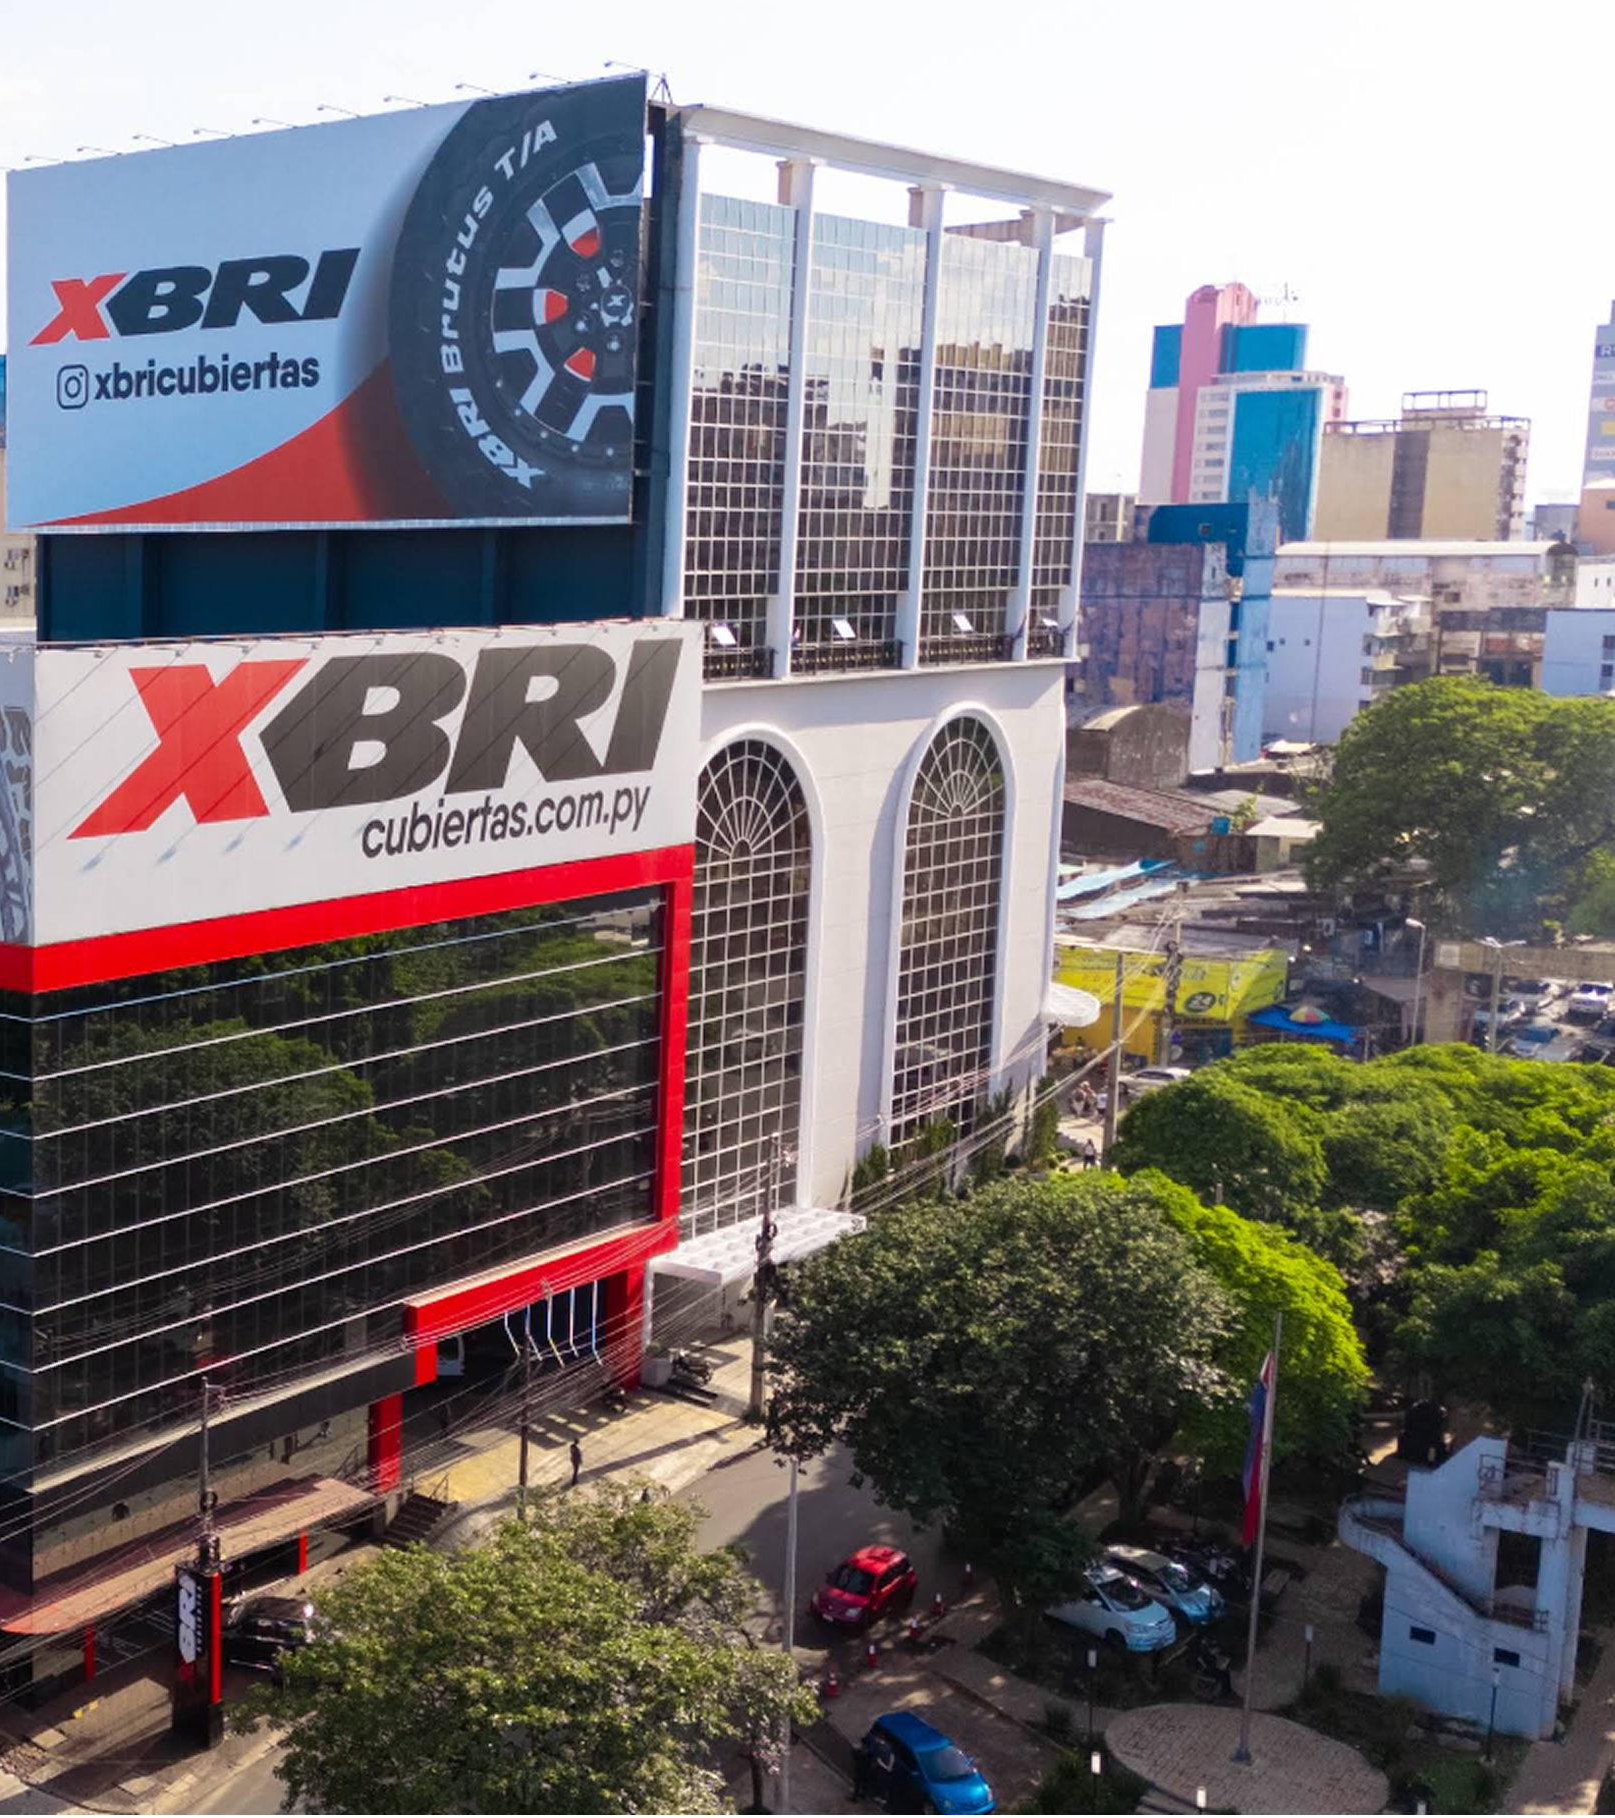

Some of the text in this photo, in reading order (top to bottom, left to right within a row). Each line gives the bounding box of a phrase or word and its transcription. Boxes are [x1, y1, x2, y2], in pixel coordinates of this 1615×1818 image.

[29, 247, 363, 346] XBRI
[440, 120, 558, 489] XBRI Brutus T/A
[94, 352, 321, 401] xbricubiertas
[67, 638, 683, 840] XBRI
[361, 786, 651, 860] cubiertas.com.py
